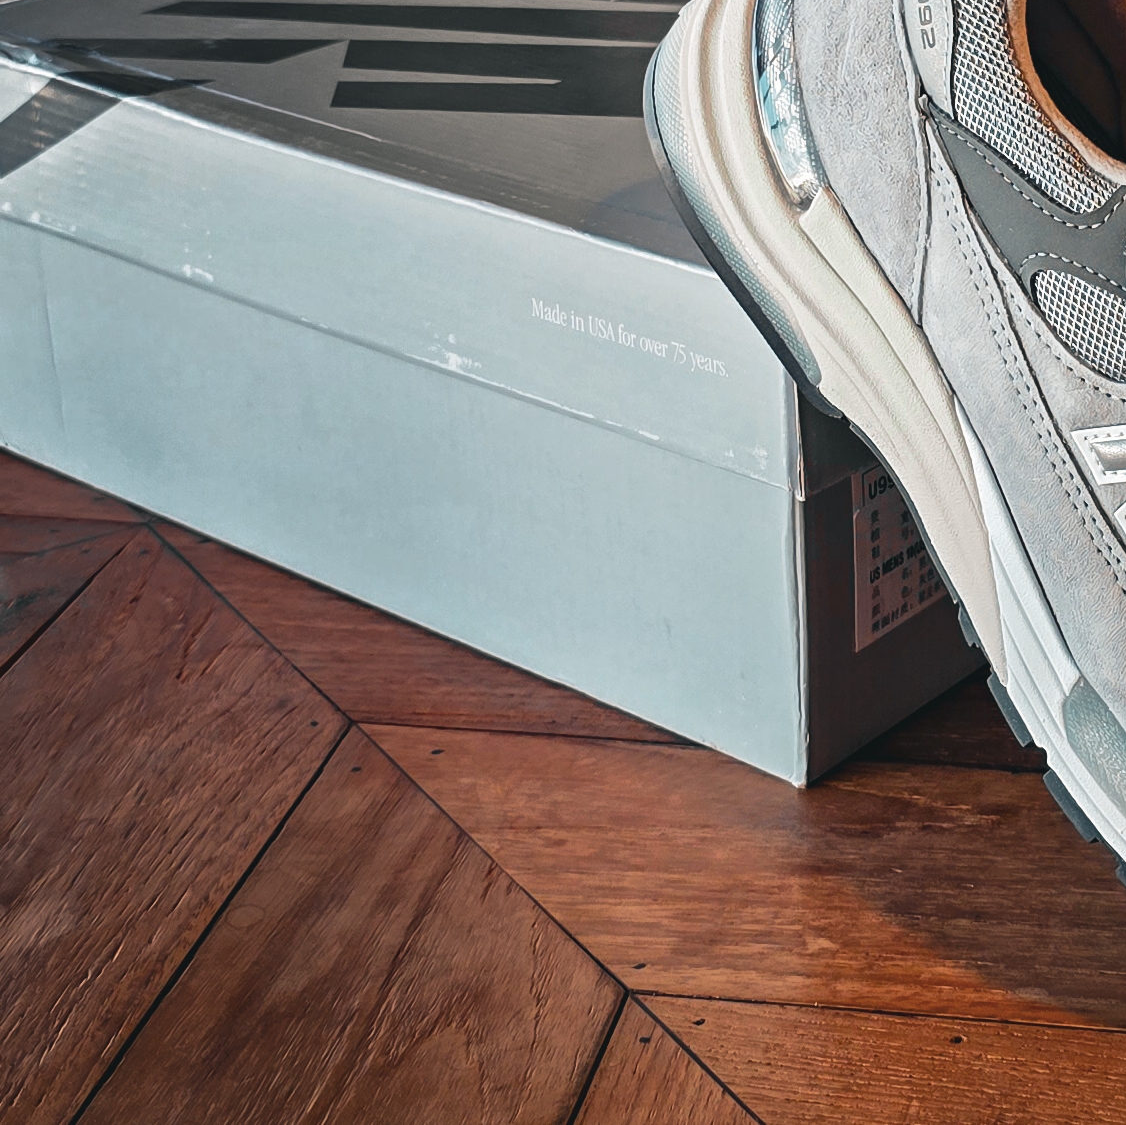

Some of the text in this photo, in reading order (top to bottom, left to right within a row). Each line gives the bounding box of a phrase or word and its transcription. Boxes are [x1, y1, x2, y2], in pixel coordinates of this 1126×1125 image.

[531, 298, 730, 378] Made in USA for over 75 years.
[869, 566, 881, 584] US
